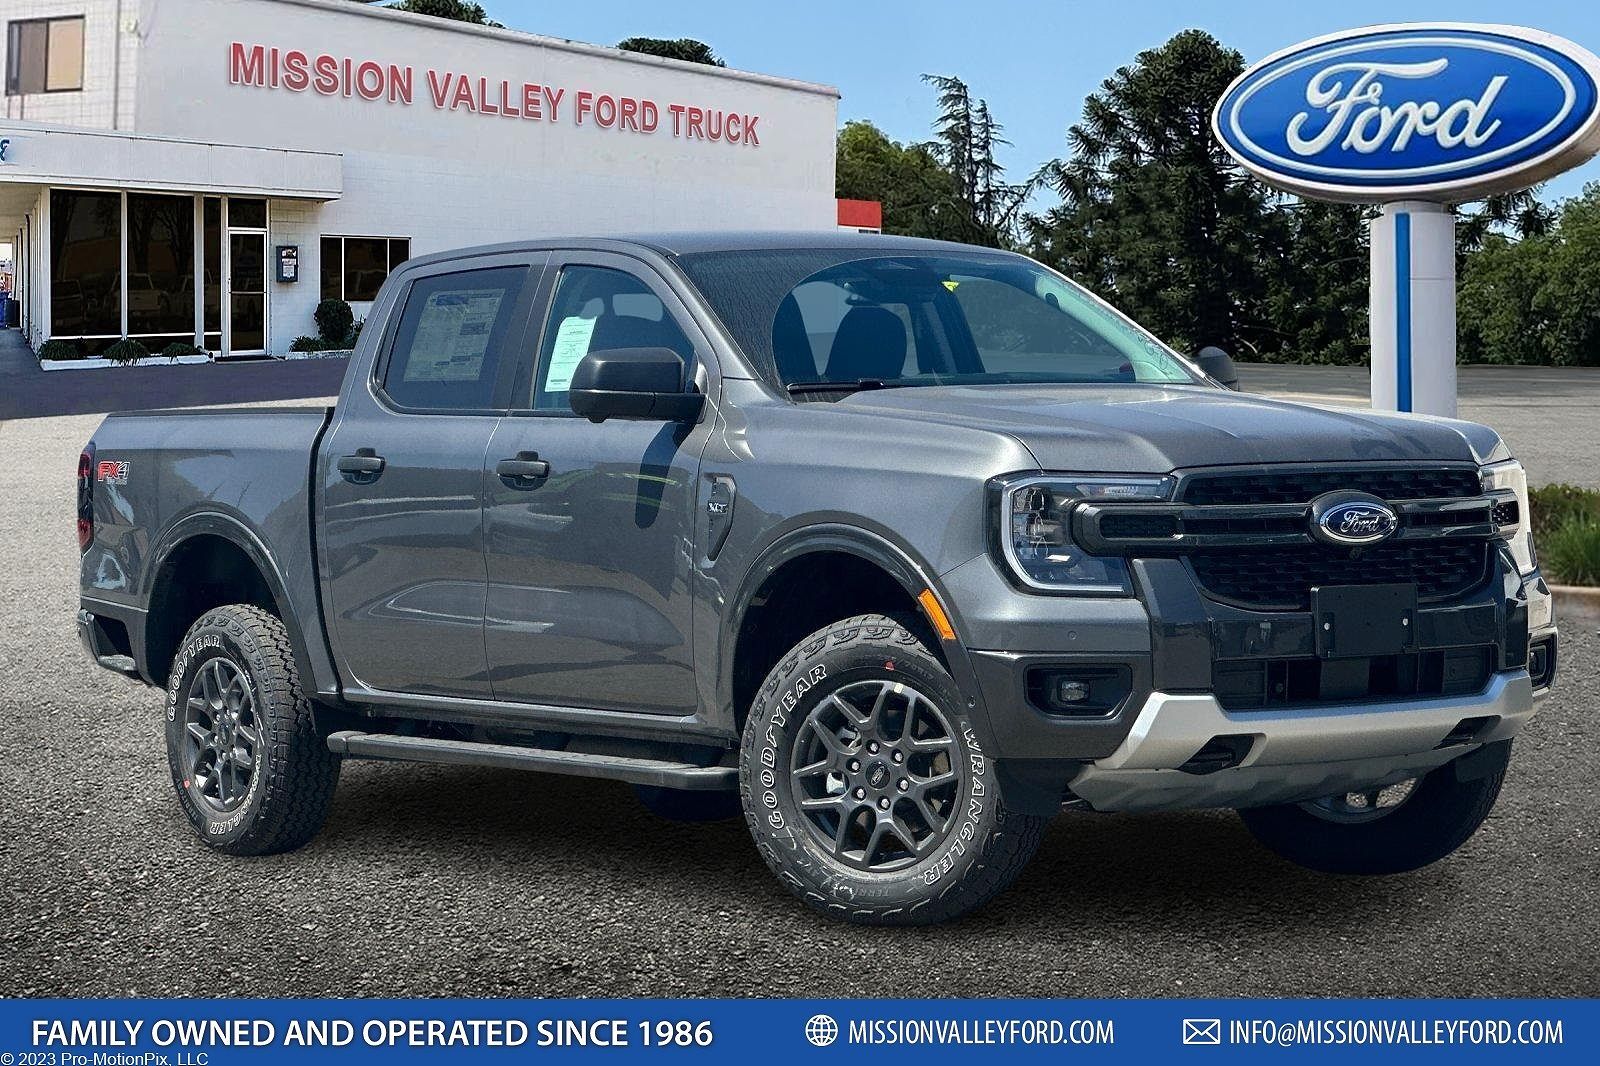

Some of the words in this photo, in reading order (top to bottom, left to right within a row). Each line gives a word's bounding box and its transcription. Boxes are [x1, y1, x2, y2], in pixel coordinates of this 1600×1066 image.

[229, 41, 413, 104] MISSION
[427, 69, 565, 122] VALLEY
[575, 90, 659, 133] FORD
[668, 103, 760, 147] TRUCK
[1287, 58, 1508, 156] Ford
[97, 461, 130, 481] FX4
[1340, 510, 1380, 533] Ford
[167, 634, 220, 721] GOODYEAR
[760, 664, 827, 829] GOODYEAR
[924, 727, 985, 885] WRANGLER
